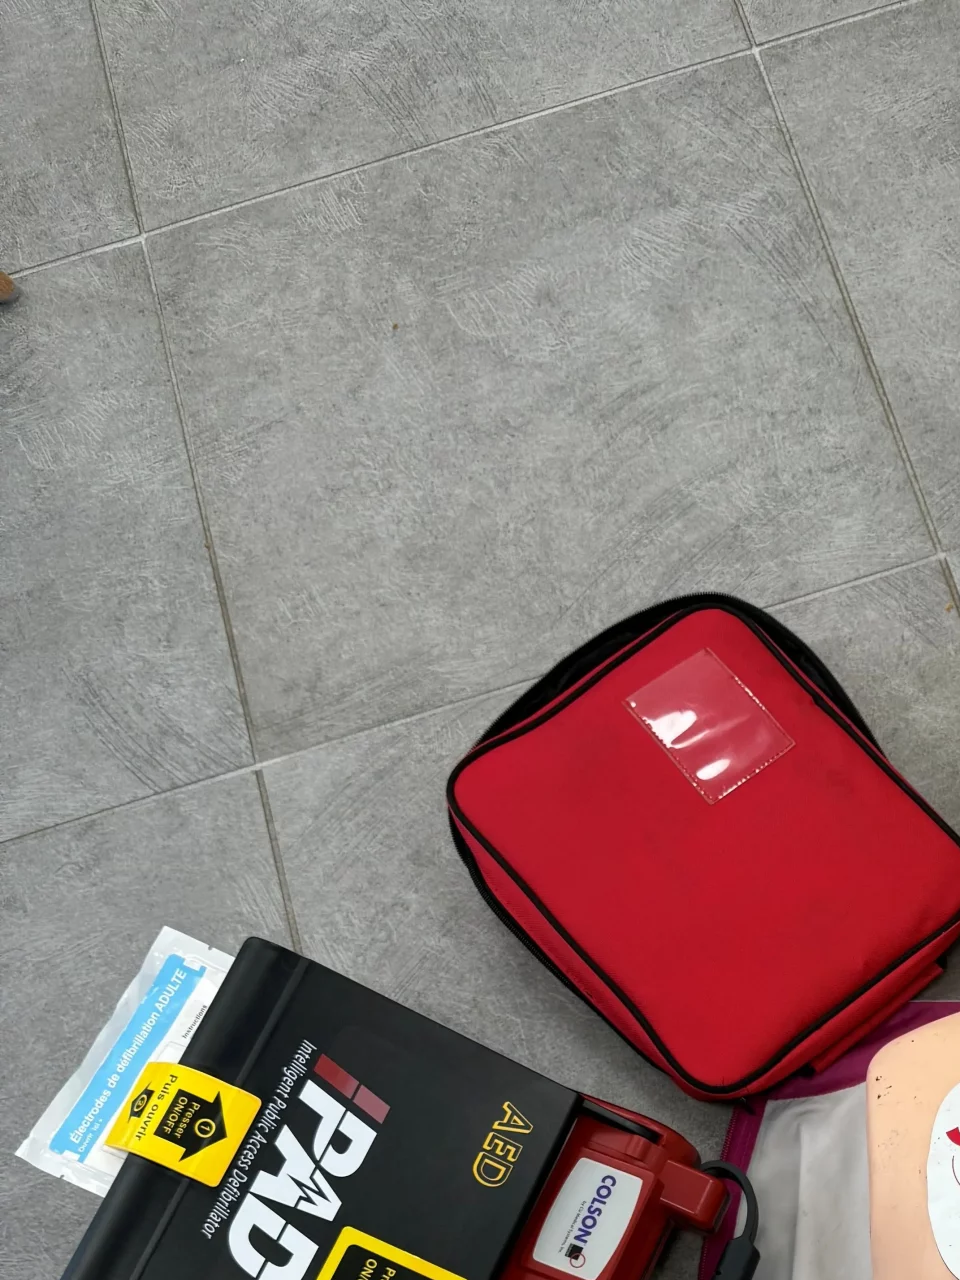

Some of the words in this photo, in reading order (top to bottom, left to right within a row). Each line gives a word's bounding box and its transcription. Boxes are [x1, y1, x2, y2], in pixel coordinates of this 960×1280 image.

[181, 1004, 208, 1039] Instructions
[69, 1089, 112, 1144] Électrodes
[107, 1073, 121, 1089] de
[115, 1012, 161, 1074] défibrillation
[155, 968, 188, 1013] ADULTE
[276, 1039, 318, 1099] Intelligent
[157, 1074, 179, 1101] Puis
[135, 1103, 159, 1141] ouvrir
[163, 1096, 188, 1135] ON/OFF
[175, 1101, 201, 1139] Presser
[258, 1096, 287, 1133] Public
[238, 1130, 268, 1171] Access
[472, 1101, 534, 1188] AED
[200, 1168, 248, 1240] Defibrillator
[573, 1174, 617, 1244] COLSON
